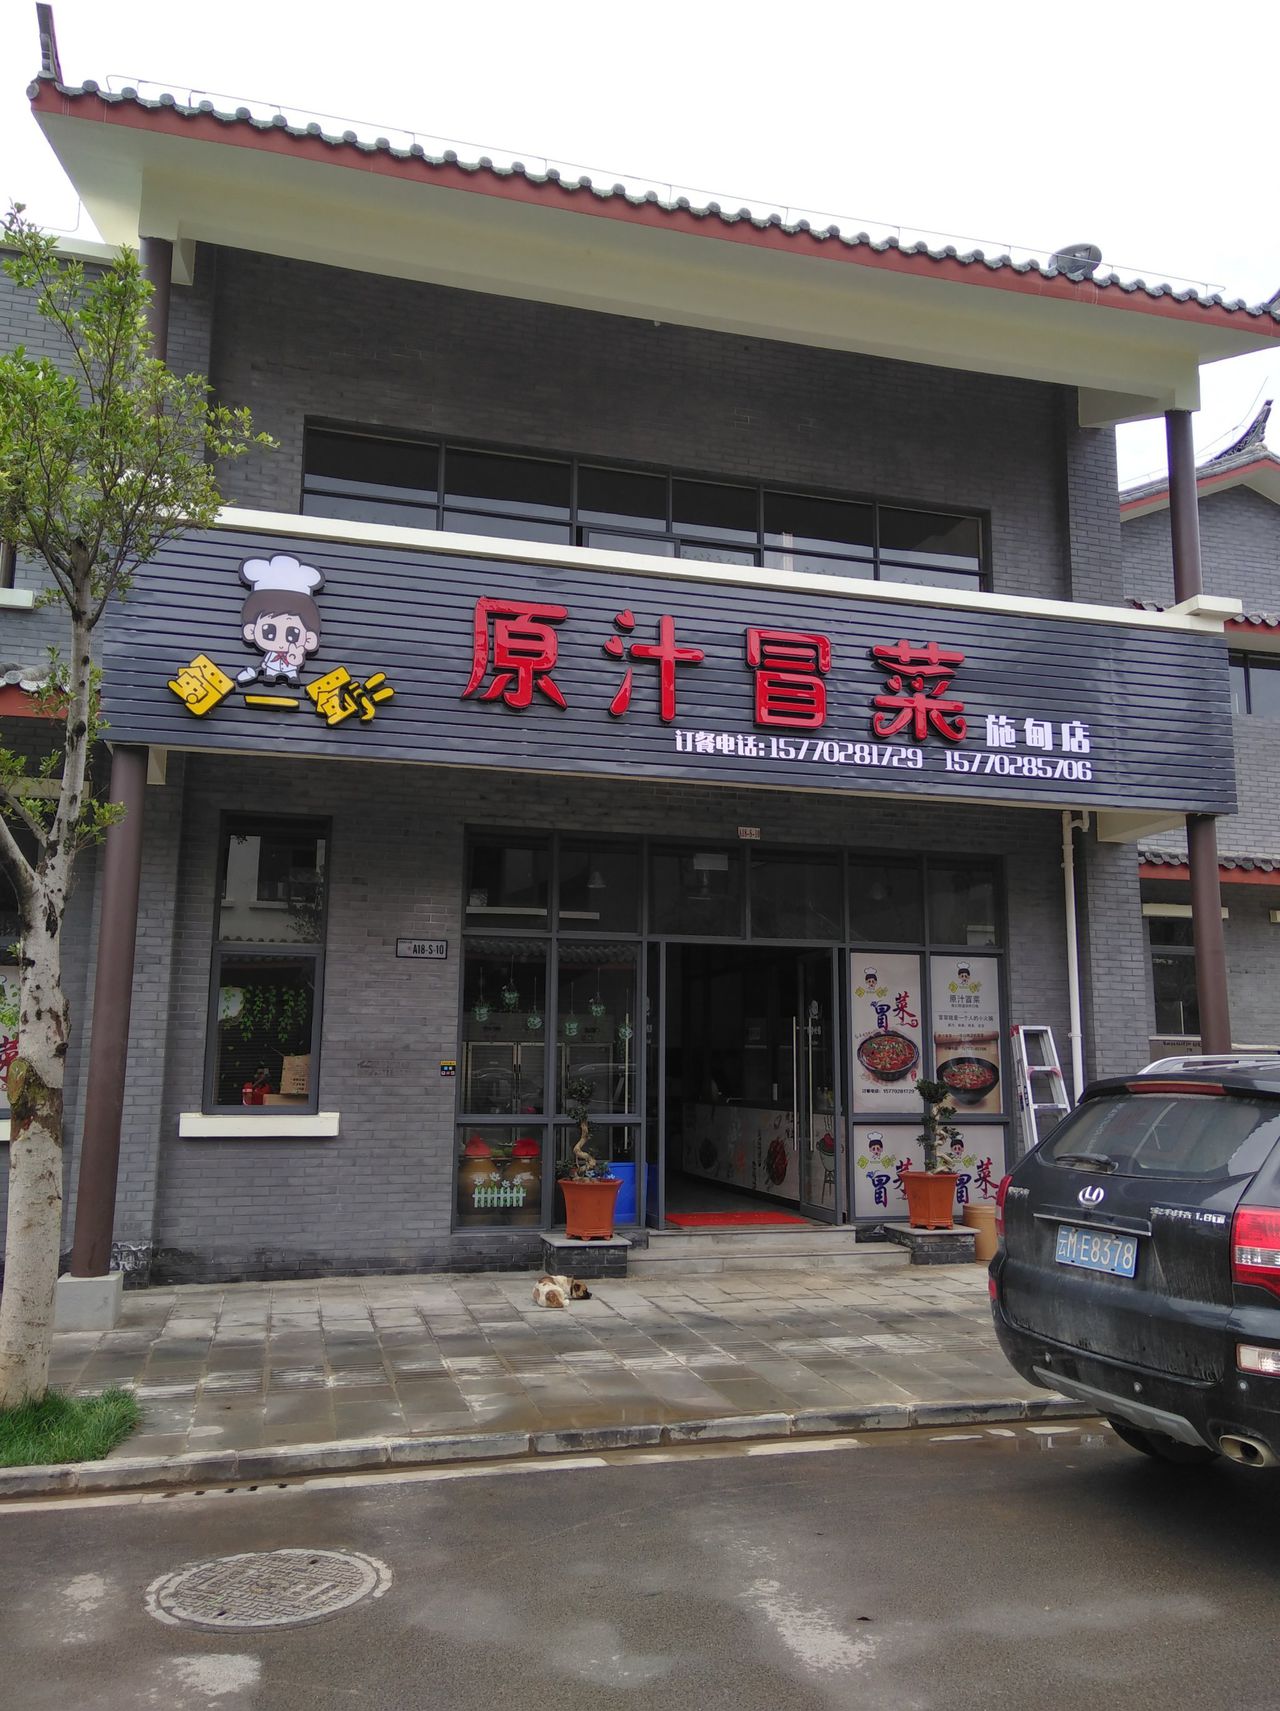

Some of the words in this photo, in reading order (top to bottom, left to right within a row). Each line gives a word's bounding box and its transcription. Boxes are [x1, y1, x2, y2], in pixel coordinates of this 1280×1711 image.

[461, 596, 967, 741] 原汁冒菜
[985, 715, 1091, 754] 施甸店
[944, 751, 1092, 781] 15770285706
[412, 944, 444, 954] A18-S-10
